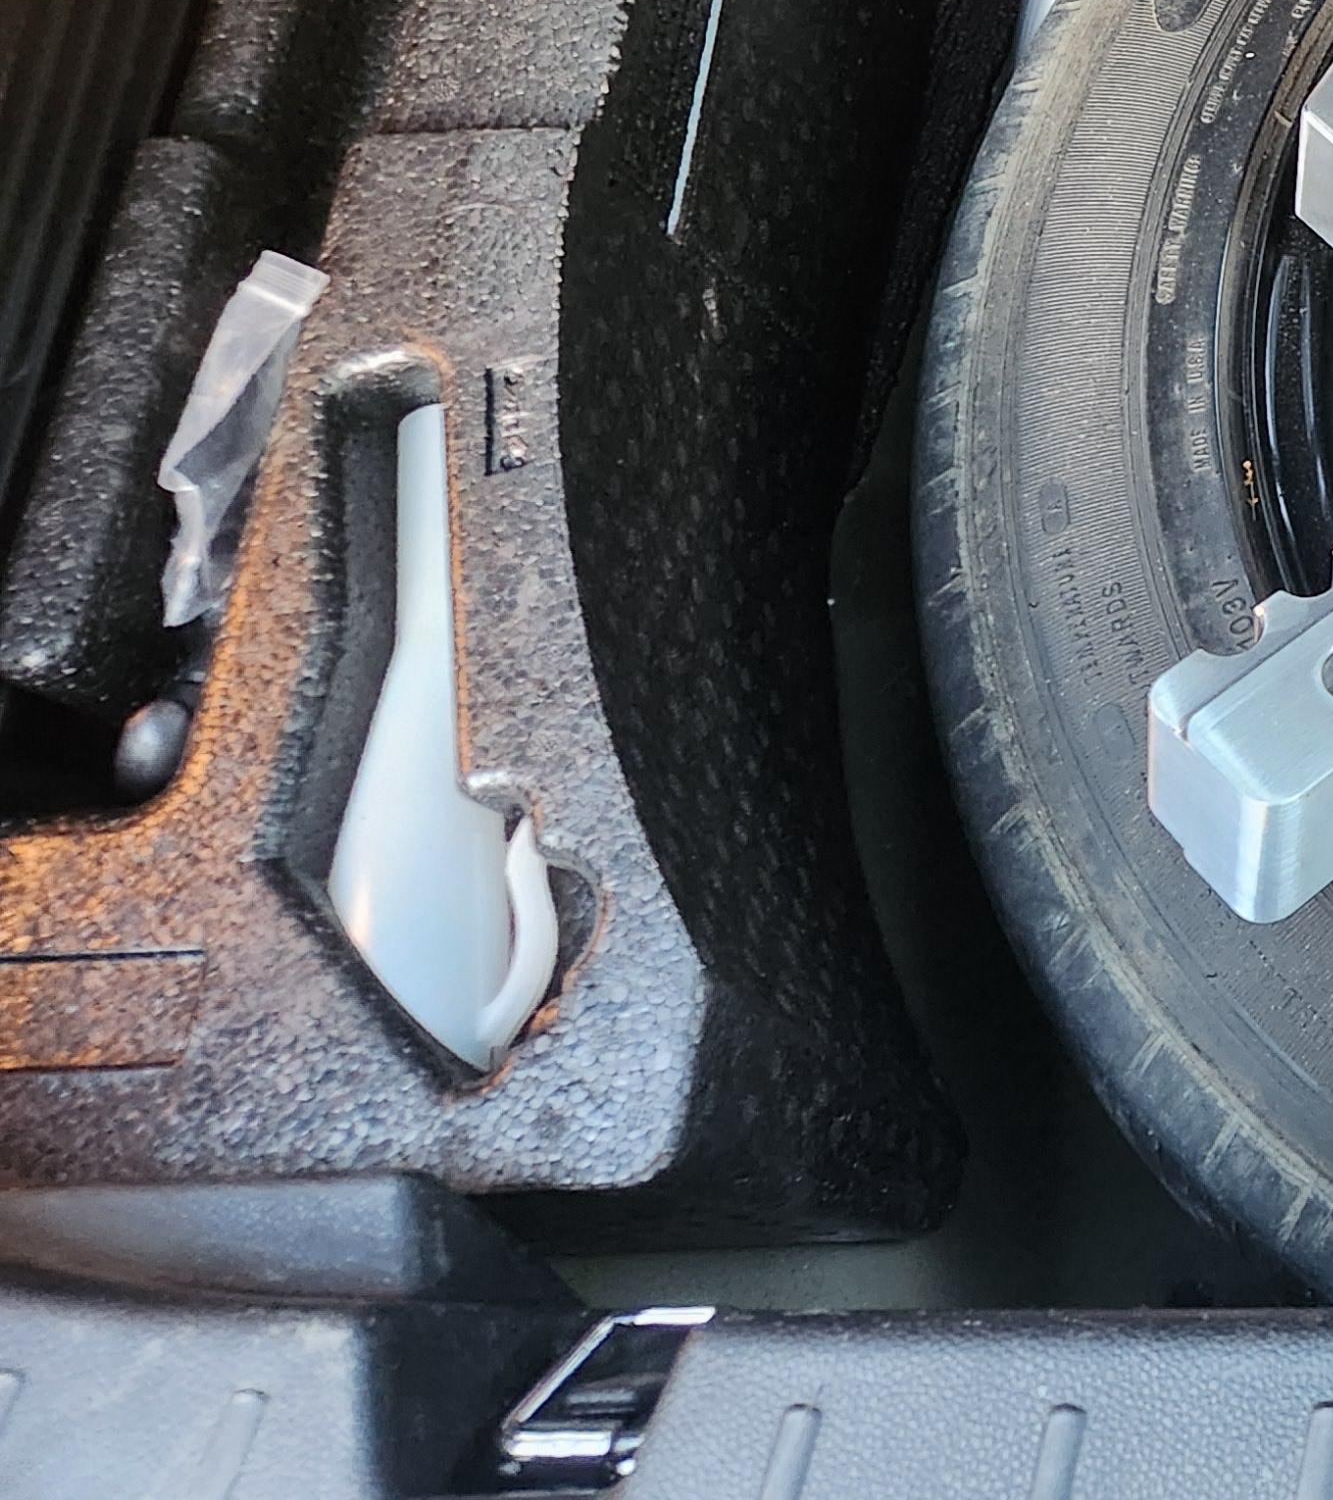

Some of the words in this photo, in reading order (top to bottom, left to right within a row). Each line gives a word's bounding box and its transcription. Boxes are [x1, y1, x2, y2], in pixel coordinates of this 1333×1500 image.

[1186, 394, 1207, 415] IN
[1188, 425, 1212, 474] MADE
[1100, 578, 1158, 702] TWARDS
